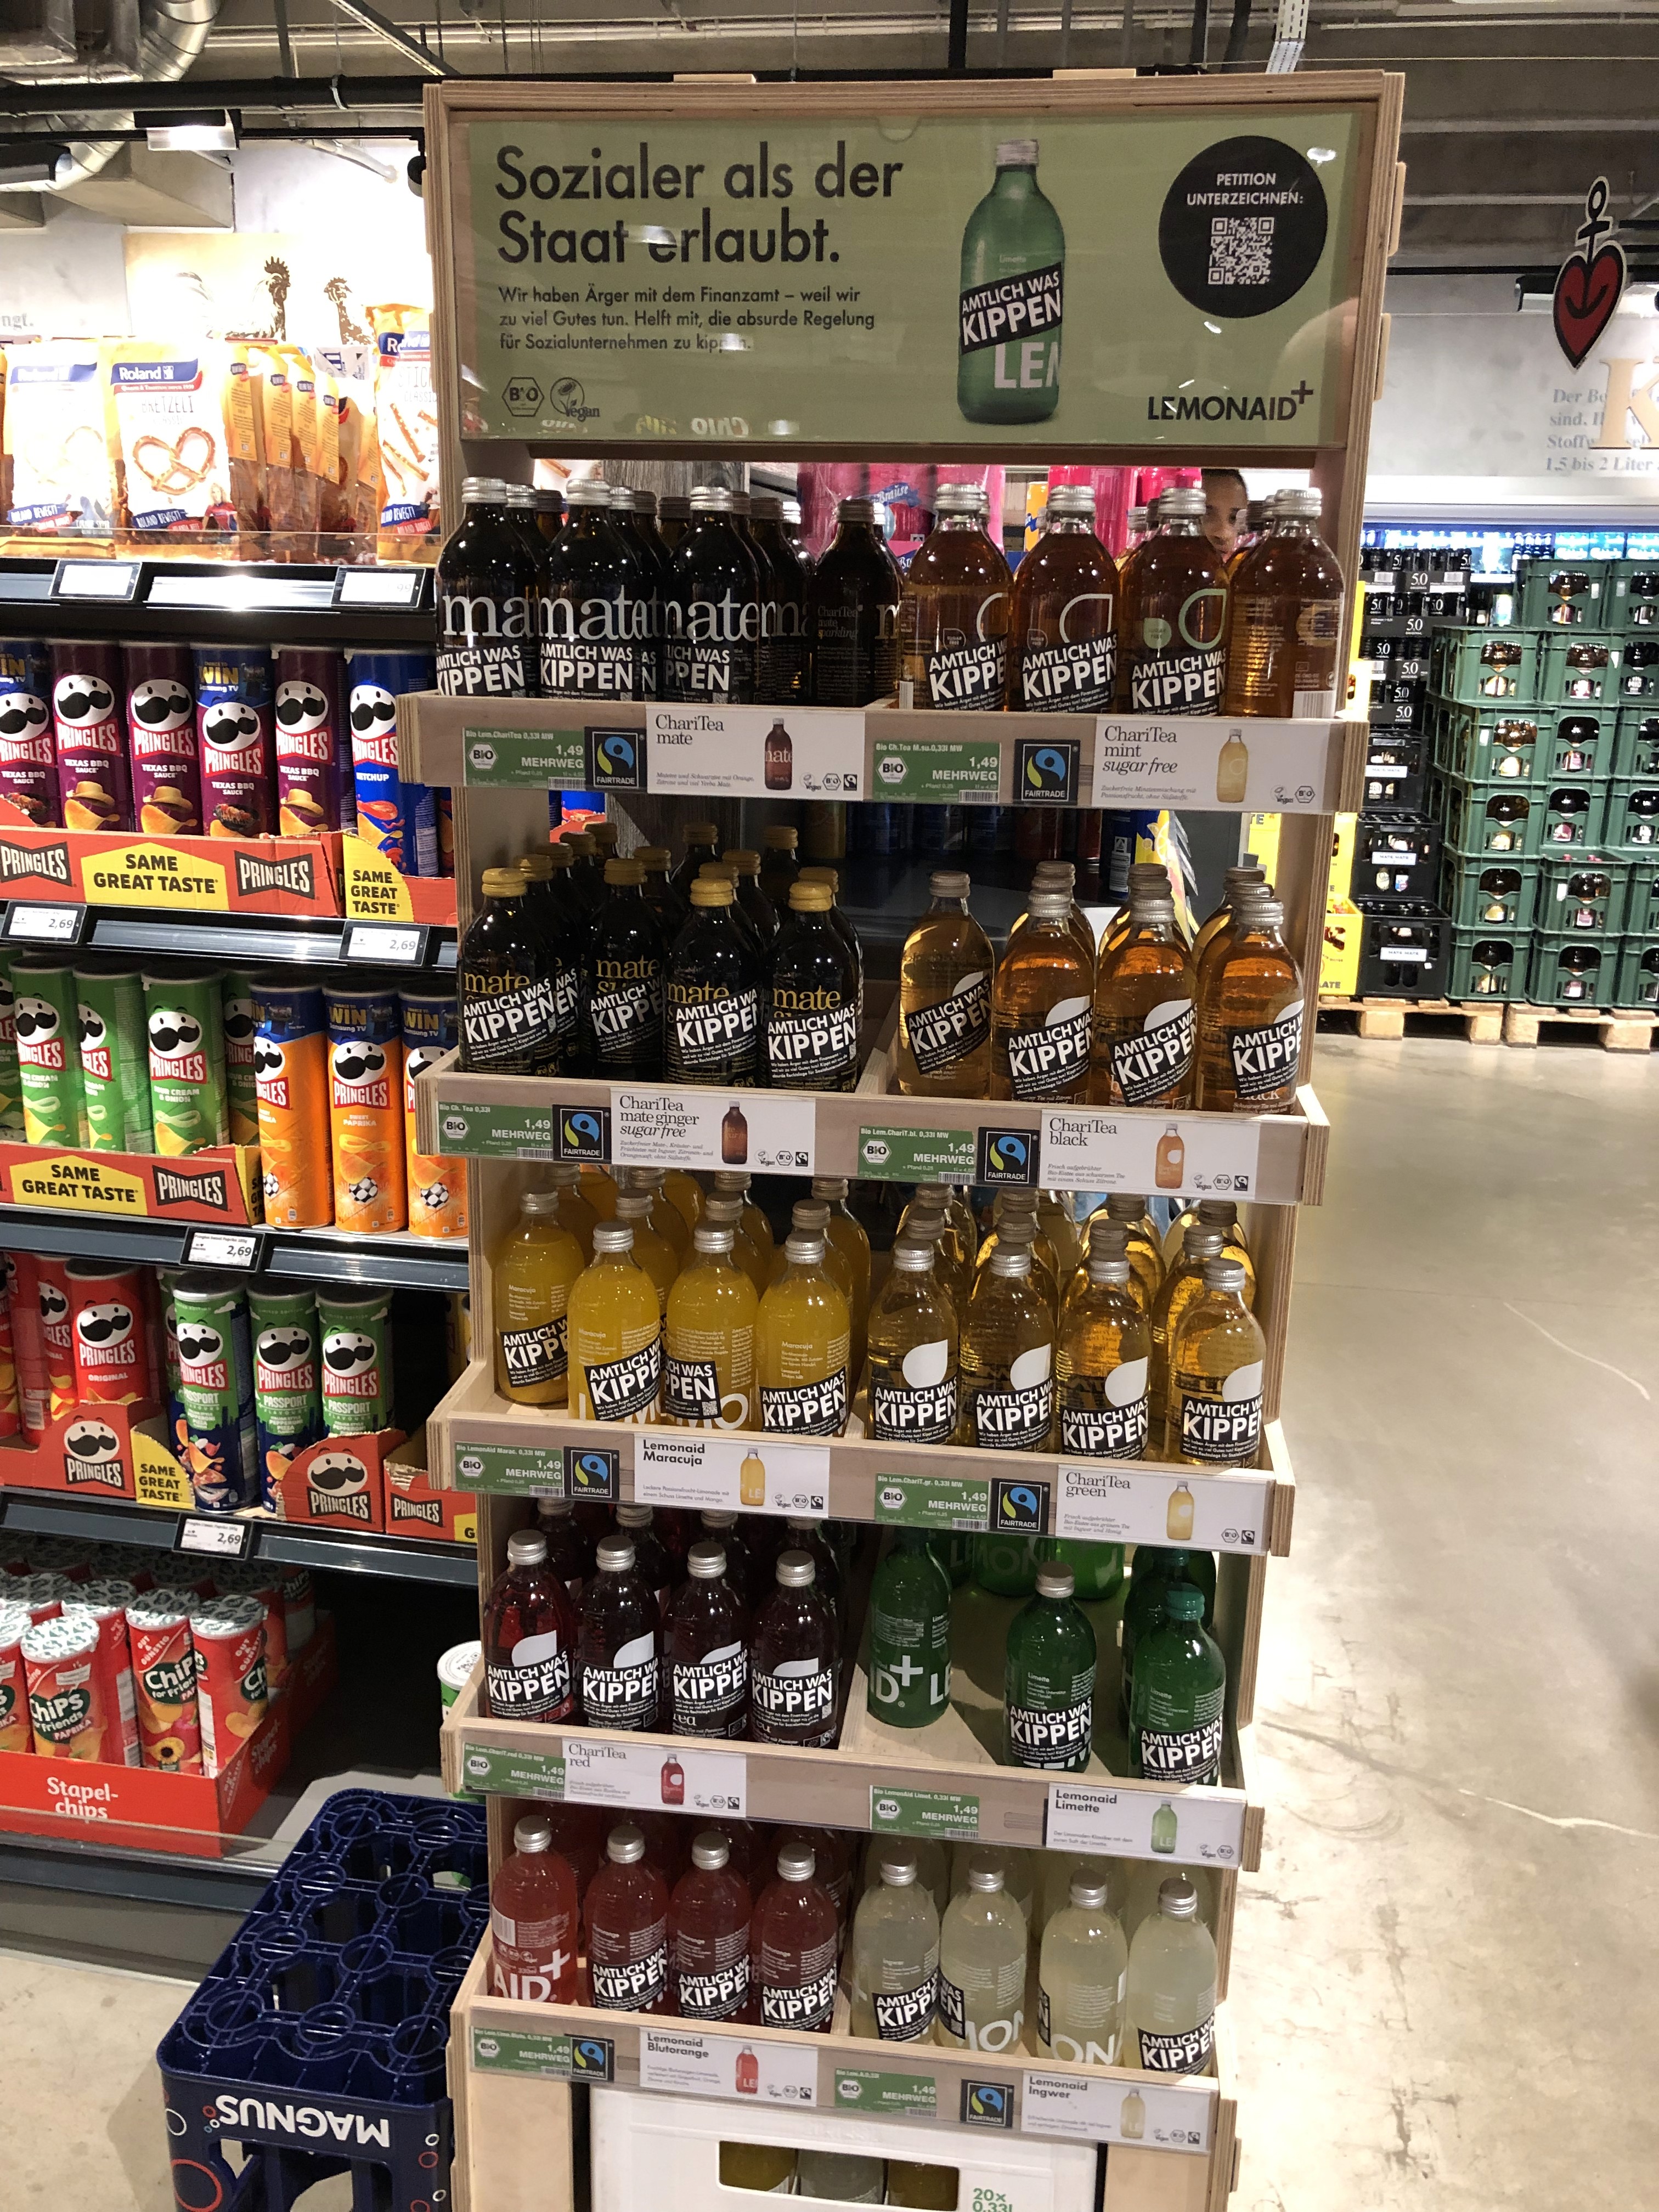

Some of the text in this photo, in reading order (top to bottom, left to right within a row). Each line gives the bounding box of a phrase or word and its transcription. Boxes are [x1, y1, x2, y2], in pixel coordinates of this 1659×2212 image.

[495, 140, 904, 200] Sozialer als der
[1216, 173, 1276, 187] PETITION
[1187, 191, 1304, 206] UNTERZEICHNEN:
[498, 206, 840, 263] Staat erlaubt.
[498, 283, 860, 306] Wir haben Ärger mit dem Finanzamt weil wir
[961, 271, 1060, 315] AMTLICH WAS
[499, 309, 874, 330] zu viel Gutes tun. Helft mit, die absurde Regelung
[962, 290, 1062, 346] KIPPEN
[500, 334, 520, 349] für
[526, 334, 668, 349] Sozialunternehmen
[673, 338, 690, 349] zu
[119, 367, 162, 380] Roland
[540, 642, 633, 661] AMTLICH WAS
[1132, 648, 1226, 680] AMTLICH WAS
[540, 659, 633, 690] KIPPEN
[1132, 663, 1226, 709] KIPPEN
[656, 714, 724, 731] ChariTea
[58, 721, 117, 753] PRINGLES
[657, 731, 693, 745] mate
[1105, 725, 1177, 743] ChariTea
[556, 744, 584, 757] 1,49
[1104, 744, 1142, 758] mint
[65, 759, 109, 768] TEXAS BBQ
[521, 757, 584, 768] MEHRWEG
[969, 757, 998, 769] 1,49
[1102, 758, 1178, 775] sugar free
[596, 776, 635, 785] FAIRTRADE
[933, 770, 997, 781] MEHRWEG
[1, 844, 68, 880] PRINGLES
[125, 853, 178, 872] SAME
[93, 872, 216, 894] GREAT TASTE
[240, 858, 311, 893] PRINGLES
[48, 918, 74, 929] 2,69
[464, 969, 530, 995] mate
[463, 978, 550, 1018] AMTLICH WAS
[773, 985, 840, 1011] mate
[329, 1005, 366, 1025] WIN
[464, 990, 556, 1043] KIPPEN
[769, 1003, 855, 1034] AMTLICH WAS
[769, 1017, 856, 1060] KIPPEN
[334, 1080, 388, 1107] PRINGLES
[619, 1096, 684, 1111] ChariTea
[524, 1119, 551, 1130] 1,49
[620, 1111, 699, 1126] mate ginger
[1049, 1118, 1118, 1135] ChariTea
[492, 1129, 551, 1141] MEHRWEG
[620, 1125, 686, 1139] sugar free
[1049, 1131, 1088, 1146] black
[948, 1143, 975, 1154] 1,49
[913, 1153, 974, 1165] MEHRWEG
[51, 1164, 100, 1182] SAME
[22, 1180, 136, 1203] GREAT TASTE
[157, 1171, 223, 1205] PRINGLES
[227, 1245, 252, 1256] 2,69
[78, 1339, 136, 1367] PRINGLES
[782, 1341, 813, 1351] Maracuja
[88, 1372, 129, 1382] ORIGINAL
[763, 1371, 845, 1404] AMTLICH WAS
[263, 1396, 307, 1408] PASSPORT
[763, 1383, 846, 1426] KIPPEN
[644, 1439, 705, 1454] Lemonaid
[537, 1459, 561, 1470] 1,49
[644, 1451, 702, 1466] Maracuja
[66, 1458, 122, 1487] PRINGLES
[506, 1468, 561, 1480] MEHRWEG
[1065, 1471, 1131, 1489] ChariTea
[1065, 1486, 1107, 1497] green
[752, 1668, 832, 1691] AMTLICH WAS
[752, 1679, 832, 1712] KIPPEN
[1010, 1696, 1091, 1724] AMTLICH WAS
[1010, 1705, 1092, 1746] KIPPEN
[568, 1743, 627, 1759] ChariTea
[541, 1764, 565, 1776] 1,49
[569, 1757, 590, 1768] red
[511, 1769, 564, 1785] MEHRWEG
[47, 1776, 119, 1802] Stapel-
[1056, 1790, 1118, 1804] Lemonaid
[55, 1797, 109, 1824] chips
[953, 1804, 978, 1815] 1,49
[1055, 1799, 1100, 1814] Limette
[921, 1811, 978, 1824] MEHRWEG
[647, 2033, 704, 2048] Lemonaid
[647, 2042, 710, 2059] Blutorange
[1028, 2075, 1089, 2092] Lemonaid
[1028, 2086, 1071, 2101] Ingwer
[215, 2095, 391, 2148] MAGNUS
[973, 2187, 1006, 2202] 20x
